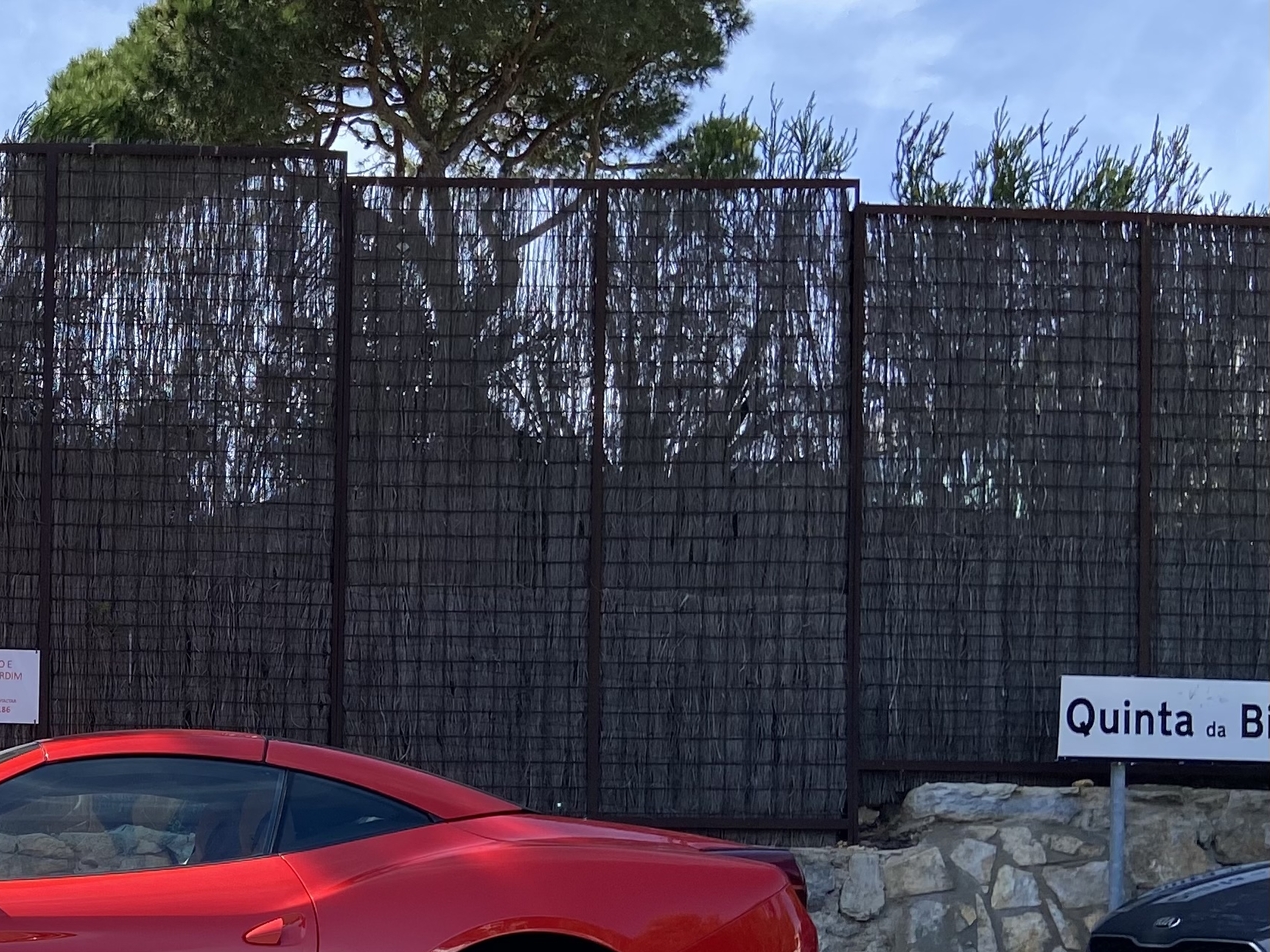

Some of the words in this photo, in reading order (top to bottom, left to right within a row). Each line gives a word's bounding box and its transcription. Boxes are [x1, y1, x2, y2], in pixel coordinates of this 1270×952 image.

[7, 660, 12, 669] E
[1066, 697, 1194, 738] Quinta
[1206, 721, 1226, 738] da
